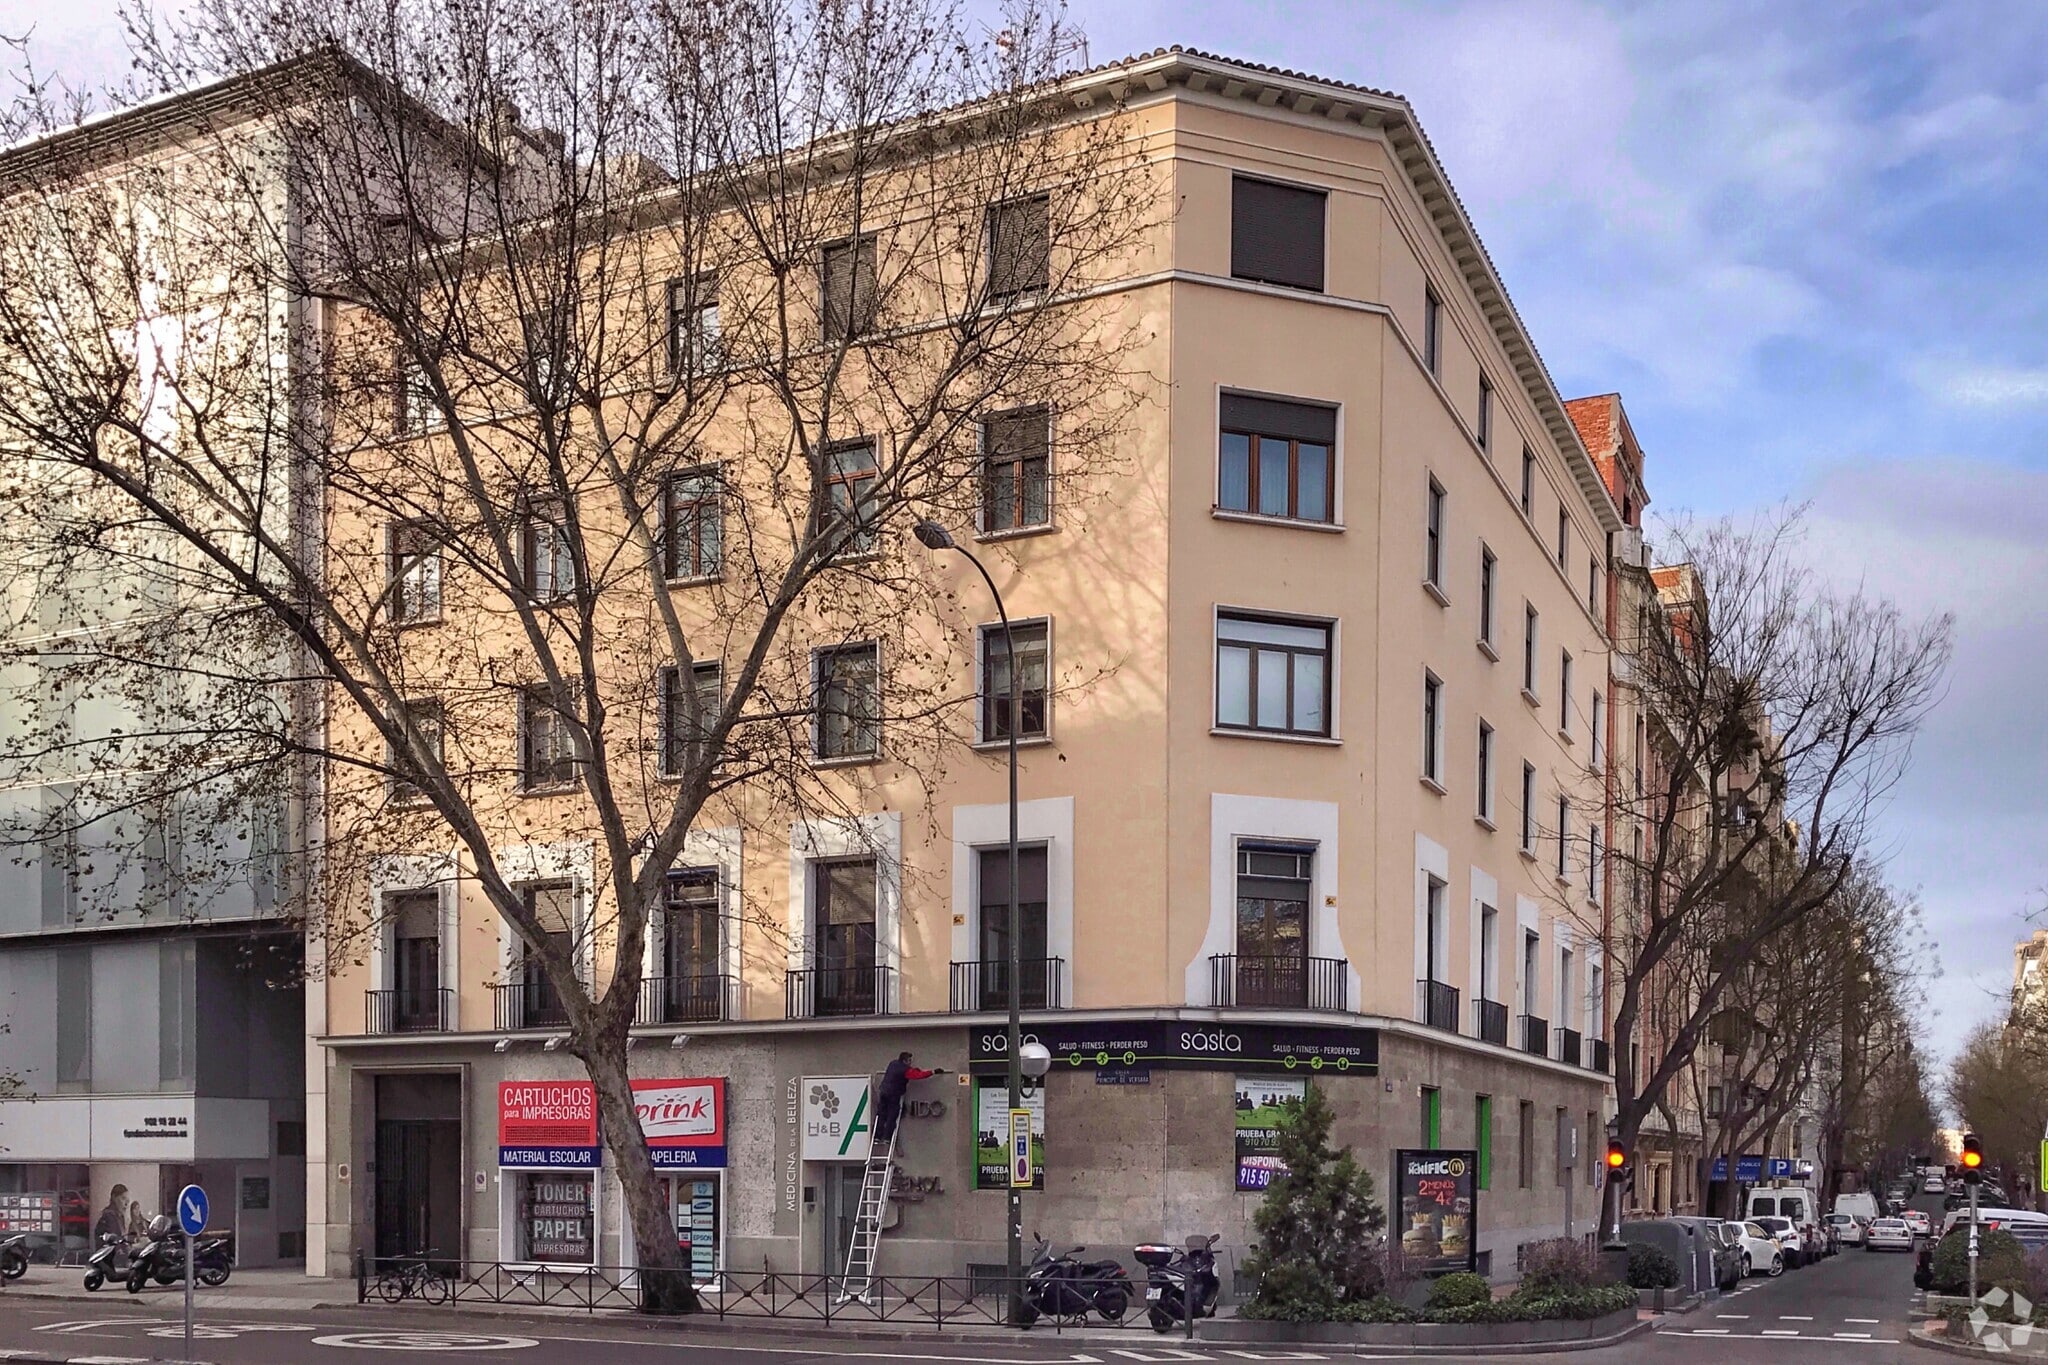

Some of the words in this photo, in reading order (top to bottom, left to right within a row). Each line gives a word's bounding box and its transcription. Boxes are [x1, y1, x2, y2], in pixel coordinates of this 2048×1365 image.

[982, 1030, 1039, 1051] sáa
[1058, 1042, 1077, 1050] SALUD
[1081, 1041, 1105, 1049] FITNESS
[1109, 1041, 1132, 1049] PERDER
[1132, 1040, 1148, 1048] PESO
[1181, 1028, 1241, 1052] sásta
[1272, 1044, 1291, 1053] SALUD
[1296, 1045, 1319, 1054] FITNESS
[1324, 1046, 1345, 1055] PERDER
[1345, 1047, 1360, 1055] PESO
[504, 1087, 591, 1106] CARTUCHOS
[786, 1077, 797, 1124] BELLEZA
[504, 1110, 519, 1120] para
[522, 1106, 591, 1120] IMPRESORAS
[1235, 1129, 1264, 1138] PRUEBA
[504, 1150, 547, 1162] MATERIAL
[549, 1151, 591, 1163] ESCOLAR
[651, 1150, 697, 1163] APELERIA
[981, 1166, 1009, 1174] PRUEBA
[1776, 1161, 1787, 1174] P
[786, 1151, 796, 1211] MEDICINA
[1240, 1167, 1256, 1184] 915
[1259, 1170, 1270, 1186] 50
[534, 1184, 584, 1201] TONER
[1418, 1180, 1428, 1195] 2
[1435, 1191, 1445, 1206] 4
[534, 1205, 585, 1215] CARTUCHOS
[534, 1220, 585, 1239] PAPEL
[533, 1243, 585, 1254] IMPRESORAS
